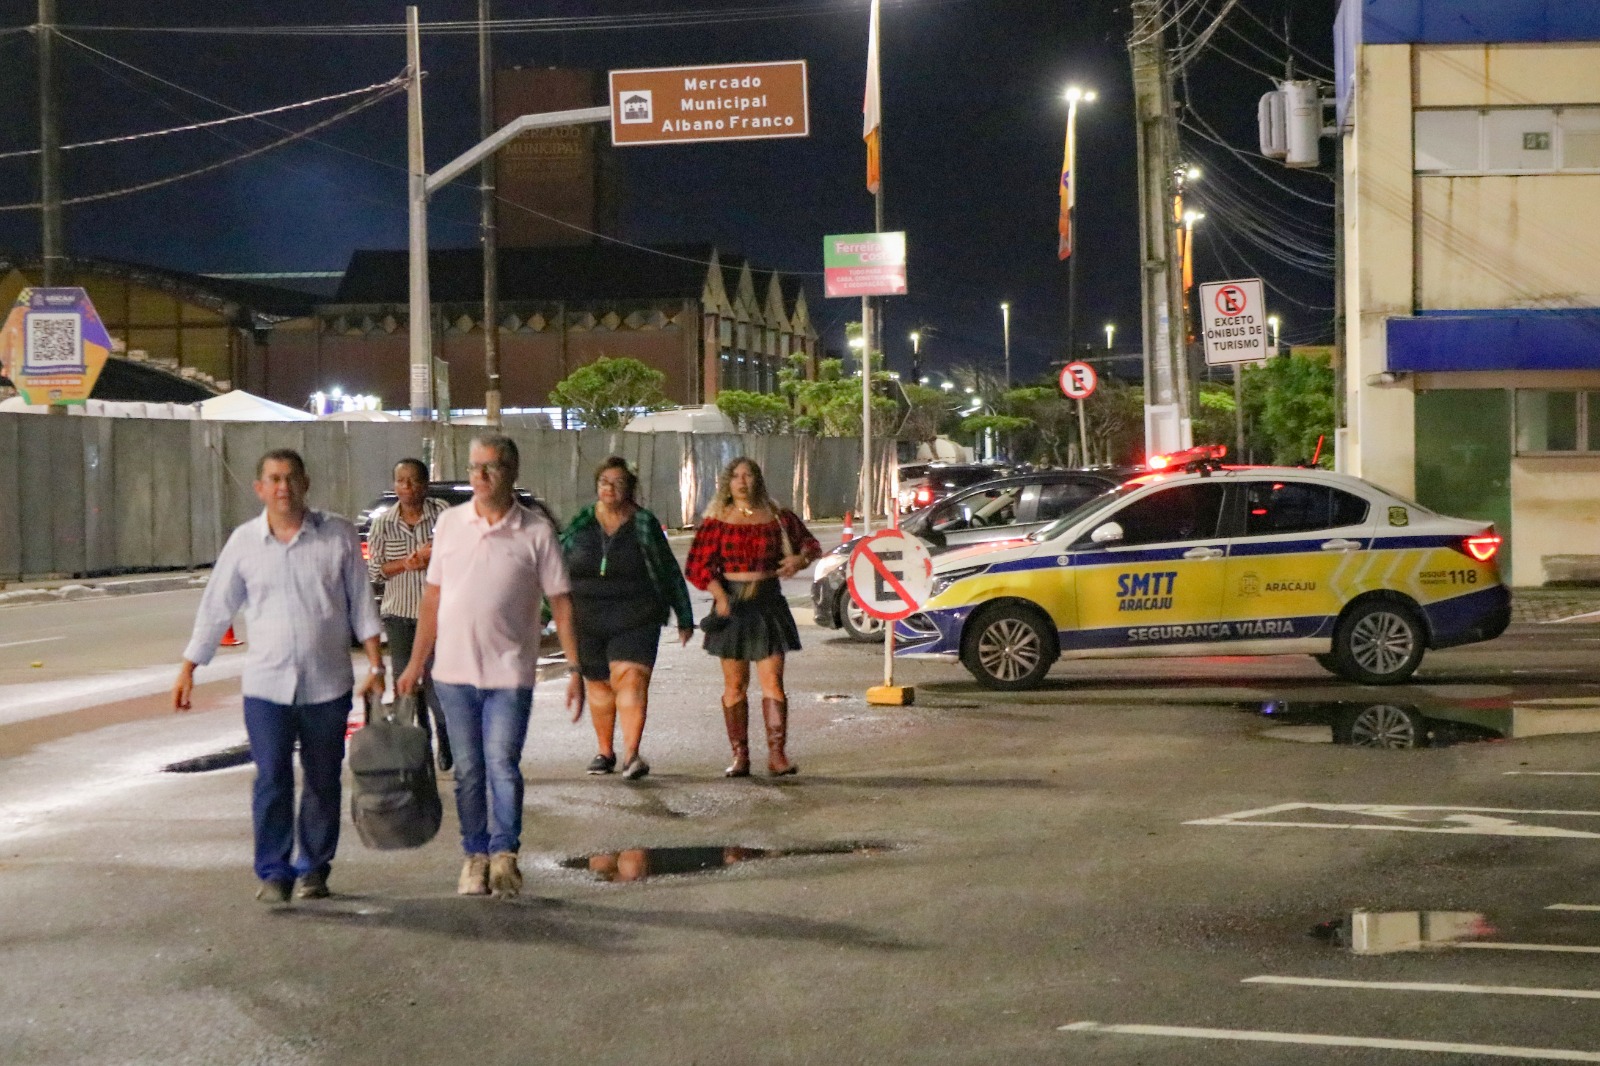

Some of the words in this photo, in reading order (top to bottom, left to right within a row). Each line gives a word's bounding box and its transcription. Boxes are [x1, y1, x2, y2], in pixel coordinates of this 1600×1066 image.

[684, 75, 762, 91] Mercado
[680, 94, 767, 112] Municipal
[661, 118, 725, 133] Albano
[729, 114, 795, 129] Franco
[518, 126, 580, 139] ERCADO
[505, 141, 582, 155] MUNICIPAL
[835, 240, 882, 253] Ferreira
[859, 252, 889, 262] Cost
[1214, 316, 1254, 327] EXCETO
[1249, 325, 1262, 335] DE
[1213, 339, 1259, 351] TURISMO
[1419, 570, 1447, 578] DISQUE
[1449, 569, 1477, 585] 118
[1115, 571, 1177, 598] SMTT
[1264, 581, 1317, 592] ARACAJU
[1118, 597, 1172, 612] ARACAJU
[1127, 622, 1231, 642] SEGURANÇA
[1234, 618, 1295, 636] VIÁRIA
